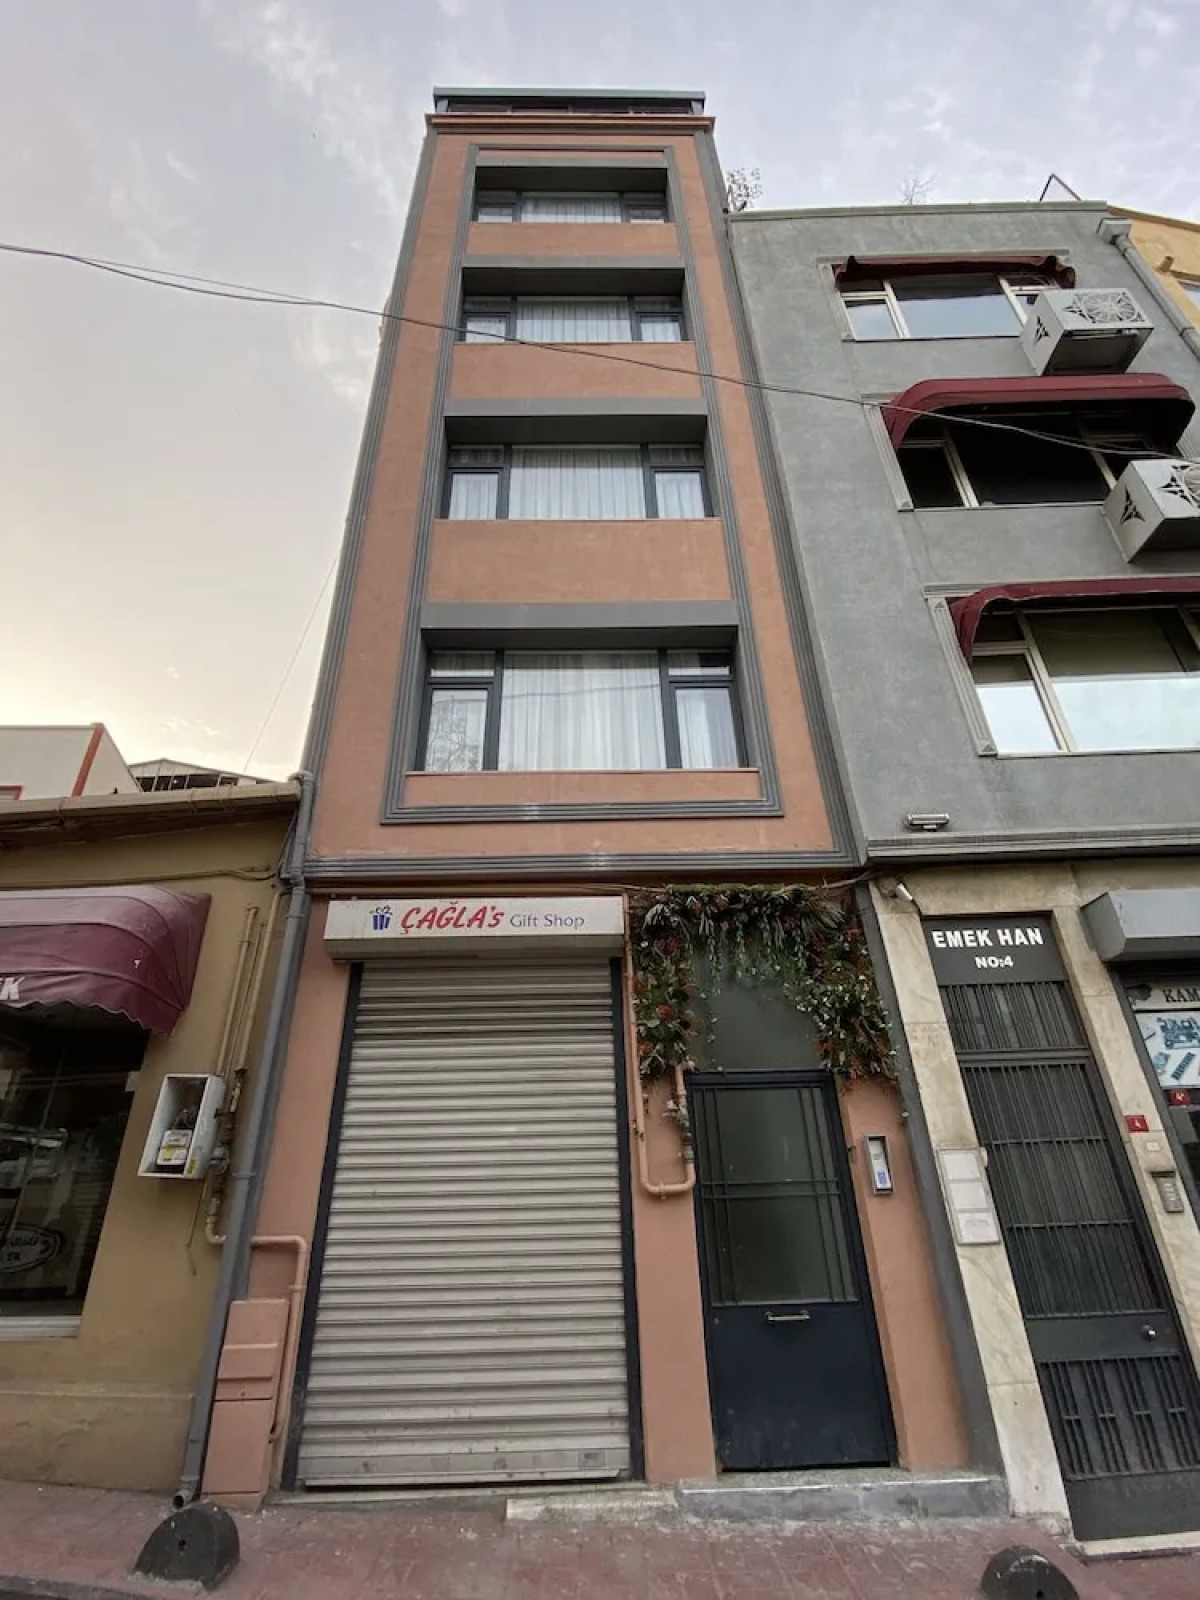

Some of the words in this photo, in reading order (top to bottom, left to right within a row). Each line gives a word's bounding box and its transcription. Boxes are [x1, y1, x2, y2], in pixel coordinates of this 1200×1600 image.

[400, 901, 505, 934] ÇAĞLA's
[510, 913, 539, 928] Gift
[544, 912, 585, 930] Shop
[931, 929, 993, 948] EMEK
[997, 927, 1044, 947] HAN
[974, 955, 1014, 969] NO:4
